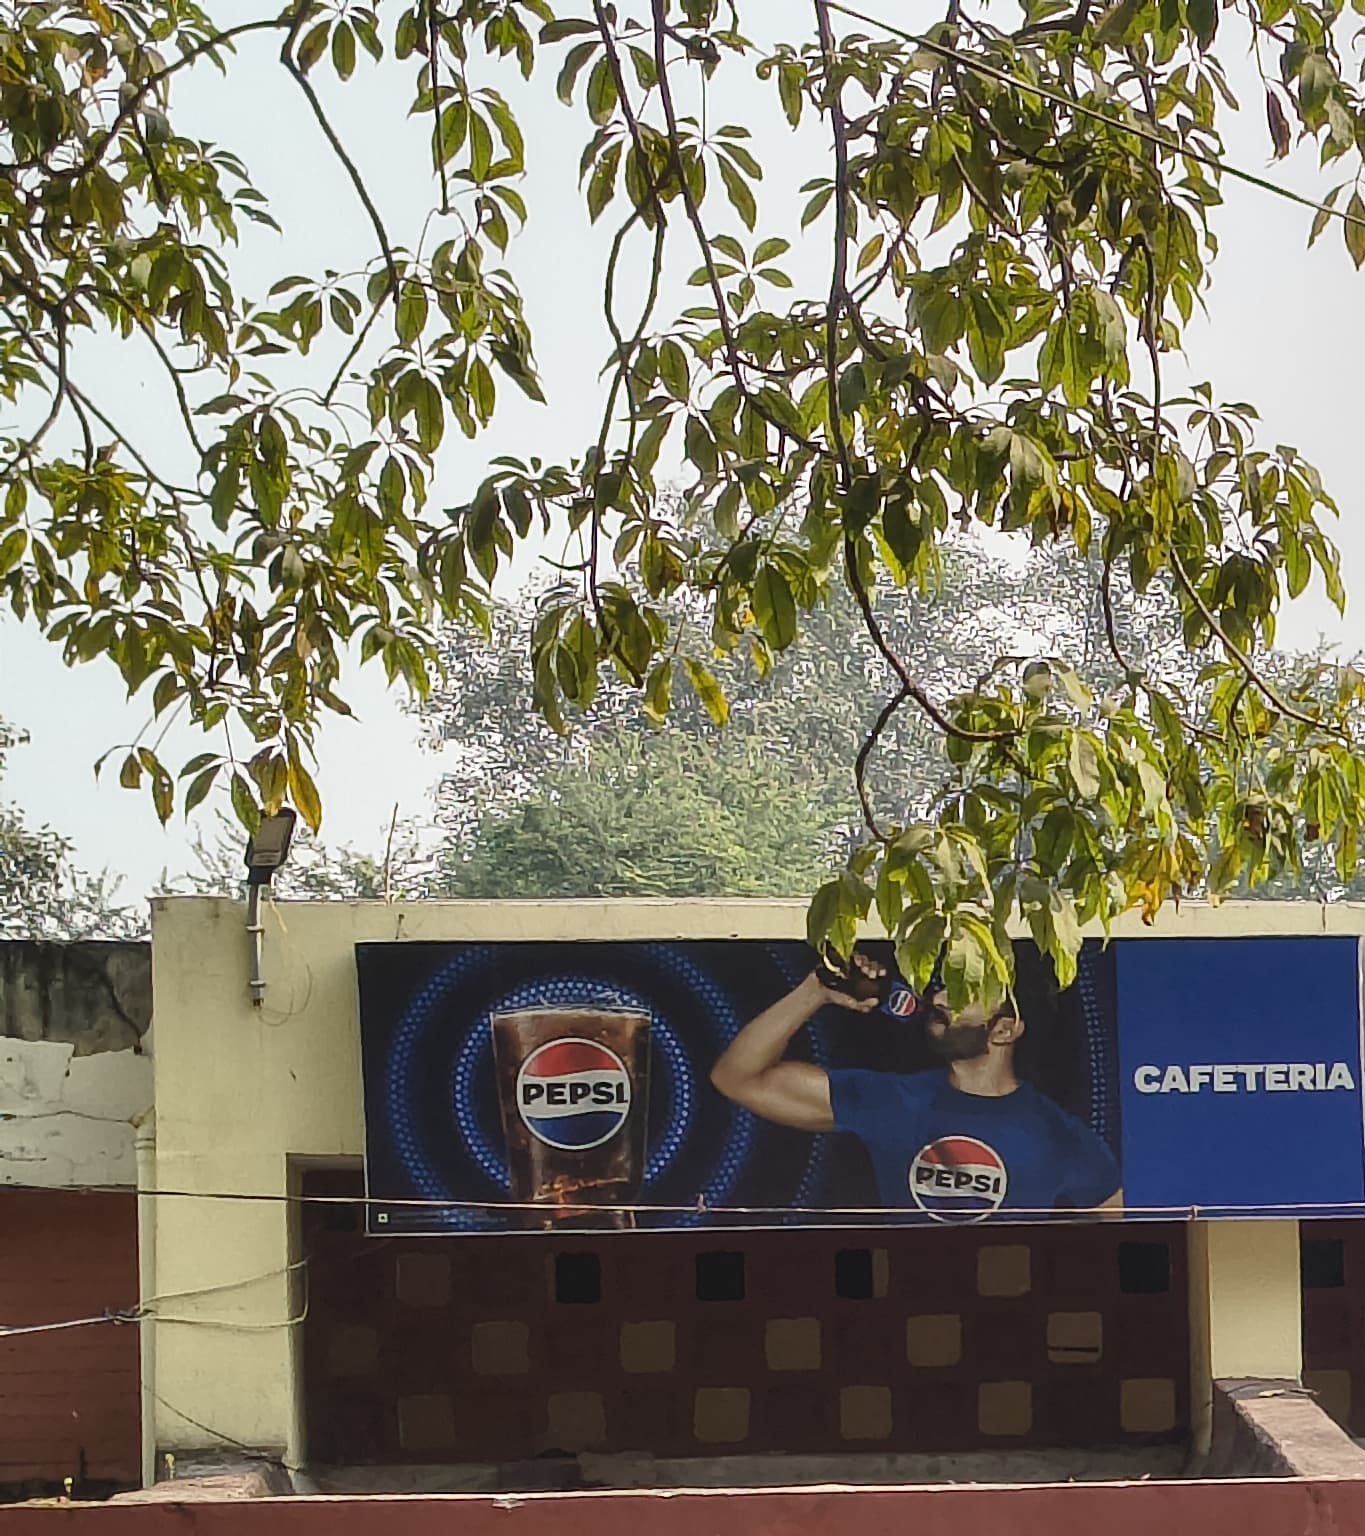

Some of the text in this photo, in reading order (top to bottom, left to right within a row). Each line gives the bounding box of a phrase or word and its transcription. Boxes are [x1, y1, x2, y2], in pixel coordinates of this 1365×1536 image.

[1133, 1061, 1355, 1094] CAFETERIA
[522, 1080, 628, 1106] PEPSI
[915, 1166, 1001, 1194] PEPSI
